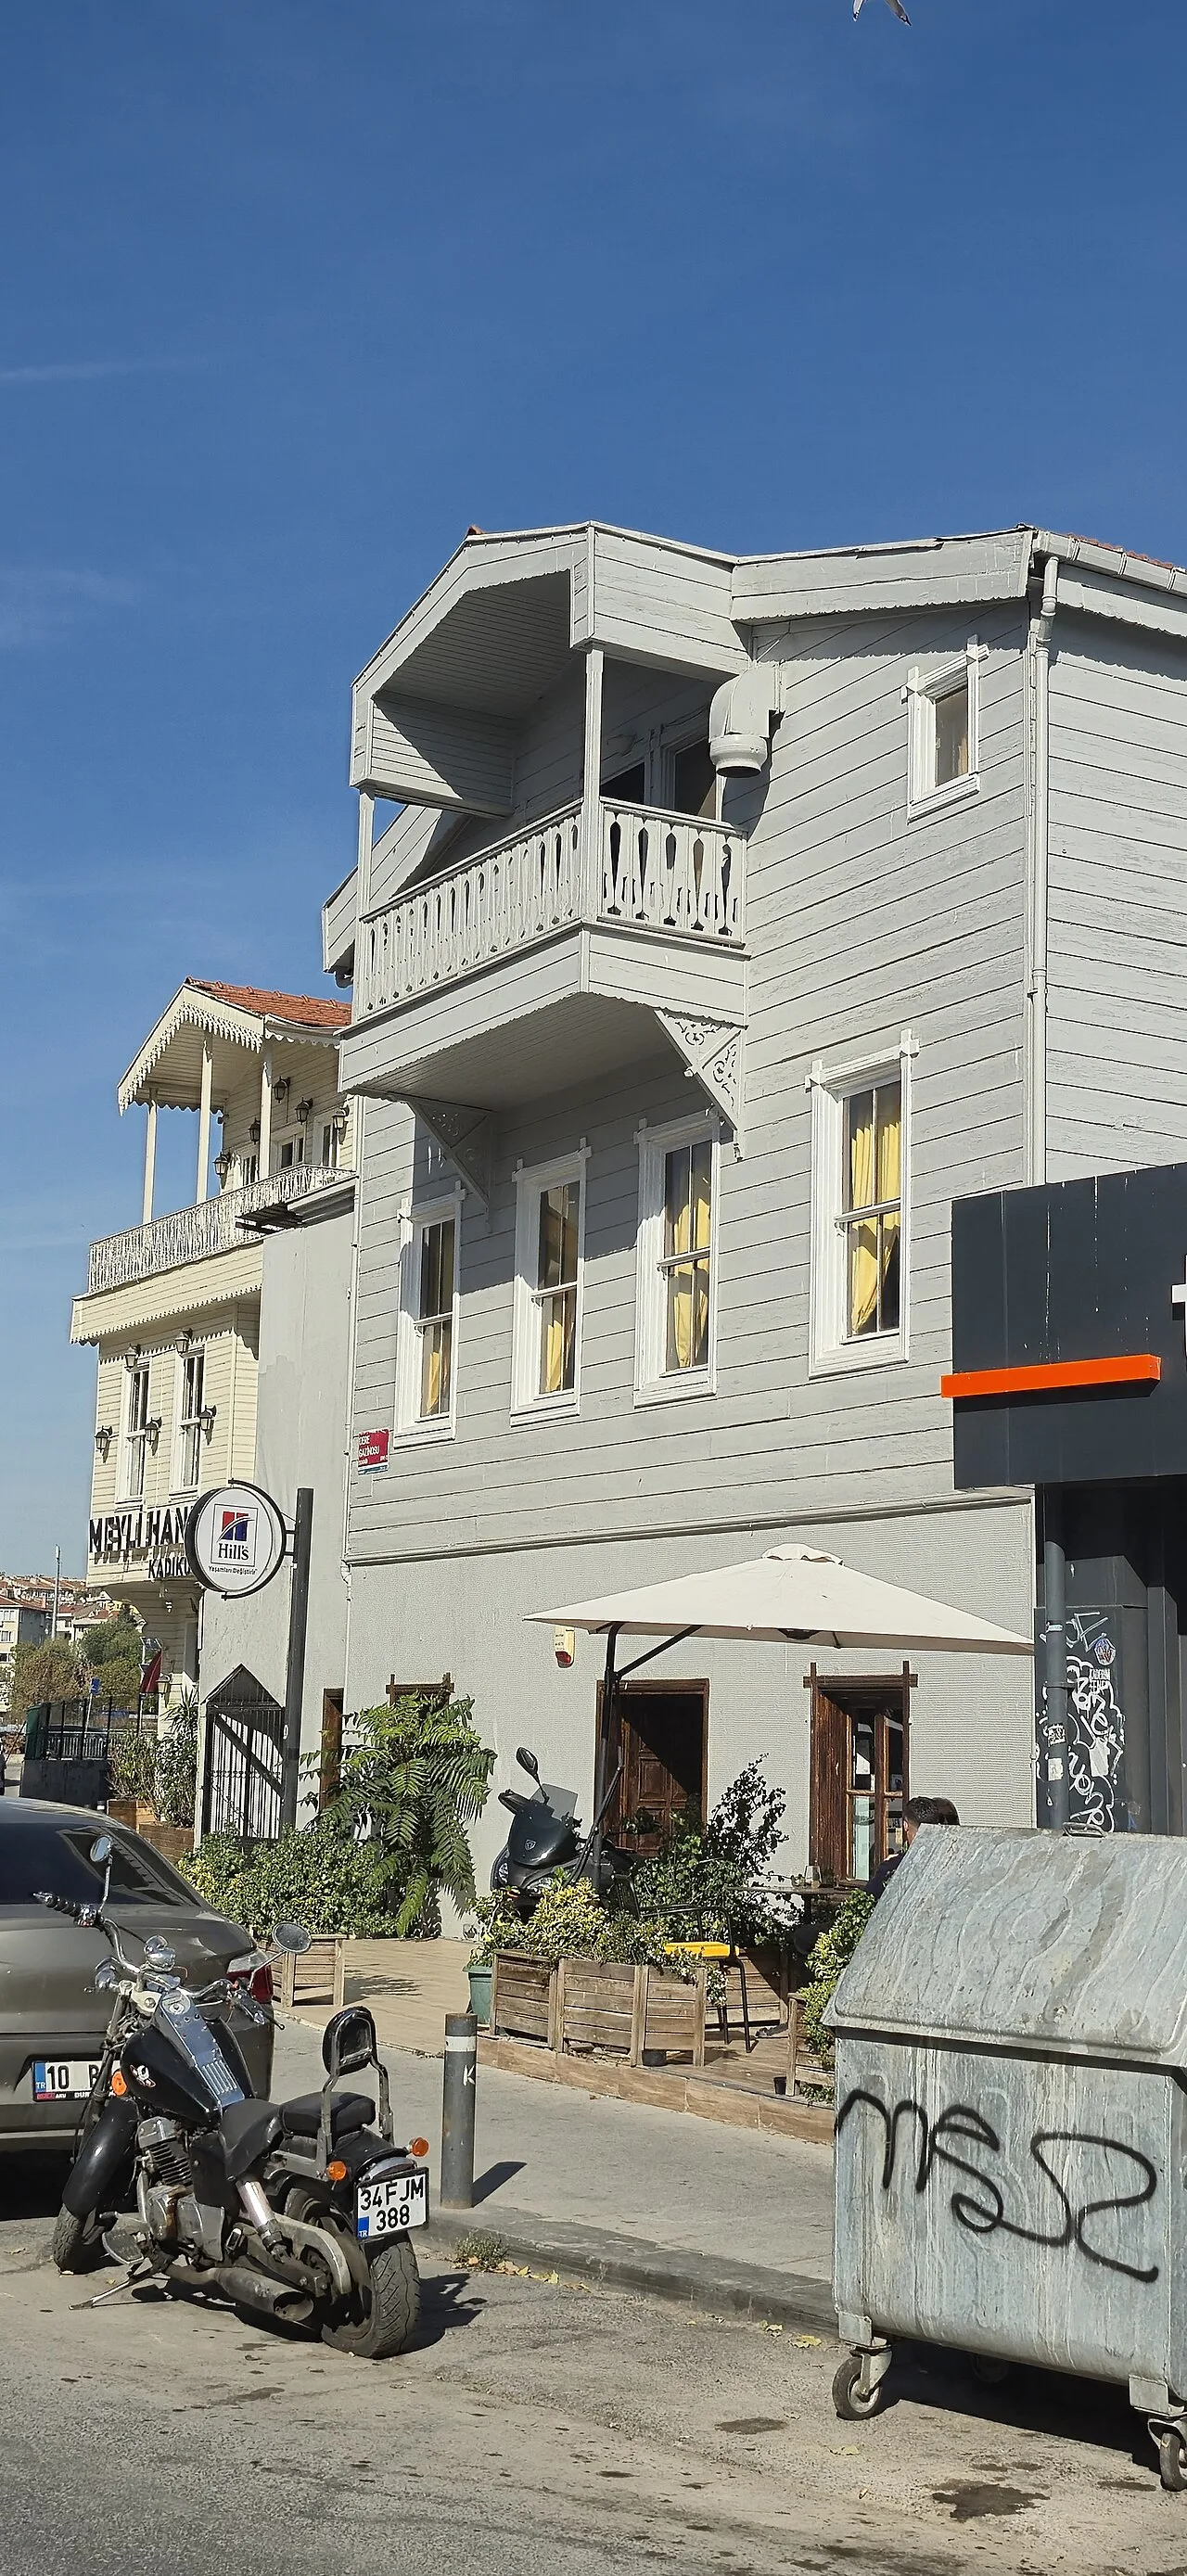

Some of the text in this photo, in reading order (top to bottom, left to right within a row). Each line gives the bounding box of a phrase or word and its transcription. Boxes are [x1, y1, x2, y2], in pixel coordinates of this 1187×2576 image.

[218, 1543, 249, 1561] Hill's
[47, 2065, 70, 2090] 10
[376, 2203, 410, 2232] 388
